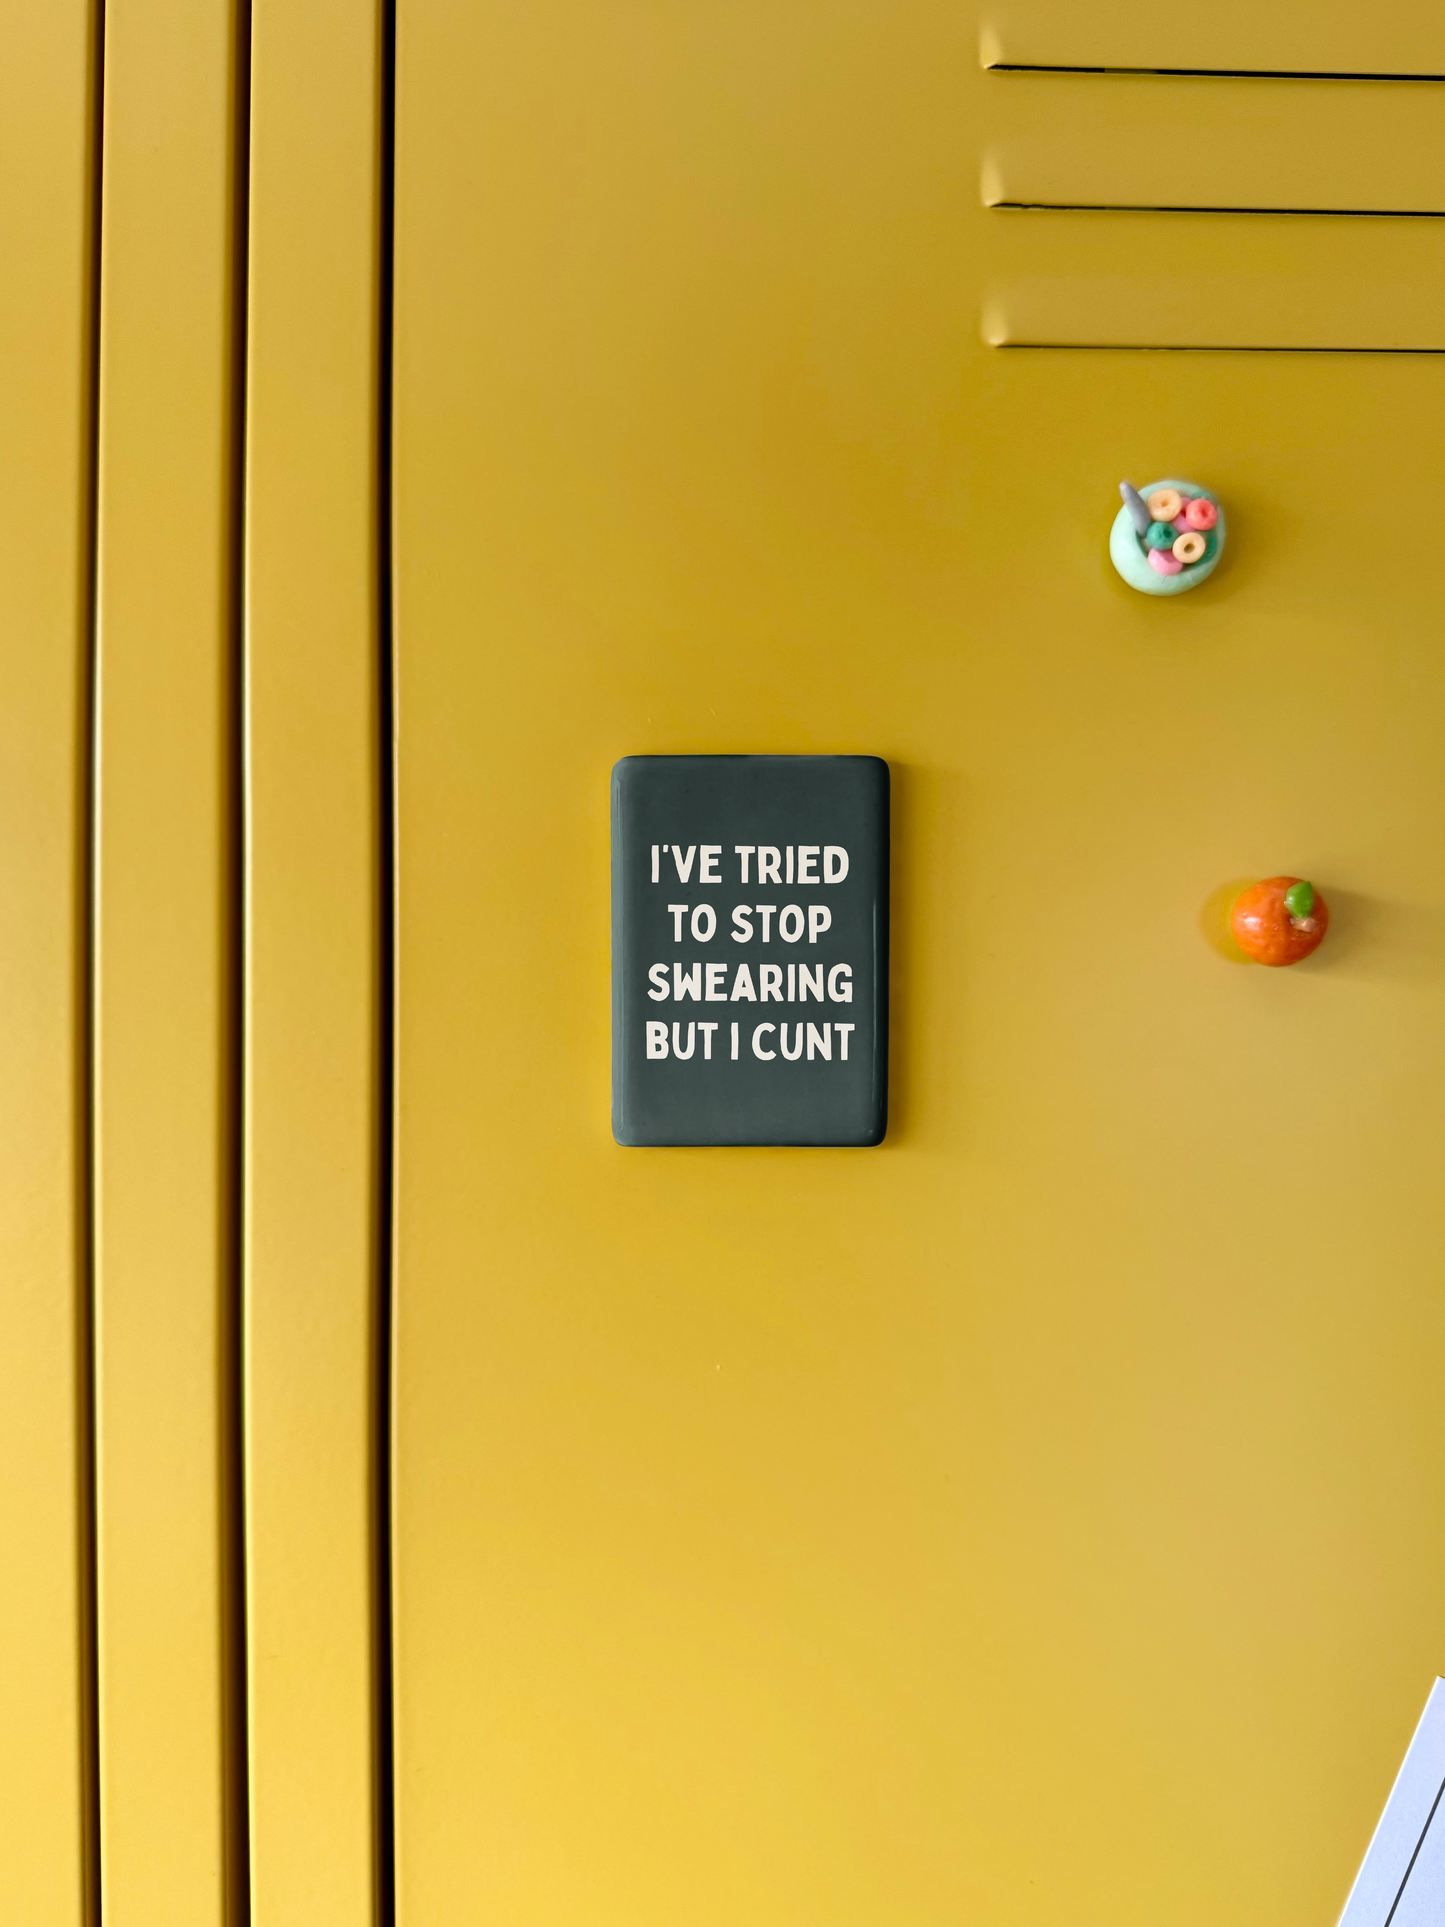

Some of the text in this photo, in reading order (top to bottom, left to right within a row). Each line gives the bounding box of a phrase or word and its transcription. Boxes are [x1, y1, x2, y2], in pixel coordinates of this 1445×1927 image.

[651, 844, 850, 884] I'VE TRIED
[668, 904, 832, 944] TO STOP
[647, 963, 853, 1003] SWEARING
[646, 1021, 855, 1061] BUT I CUNT
